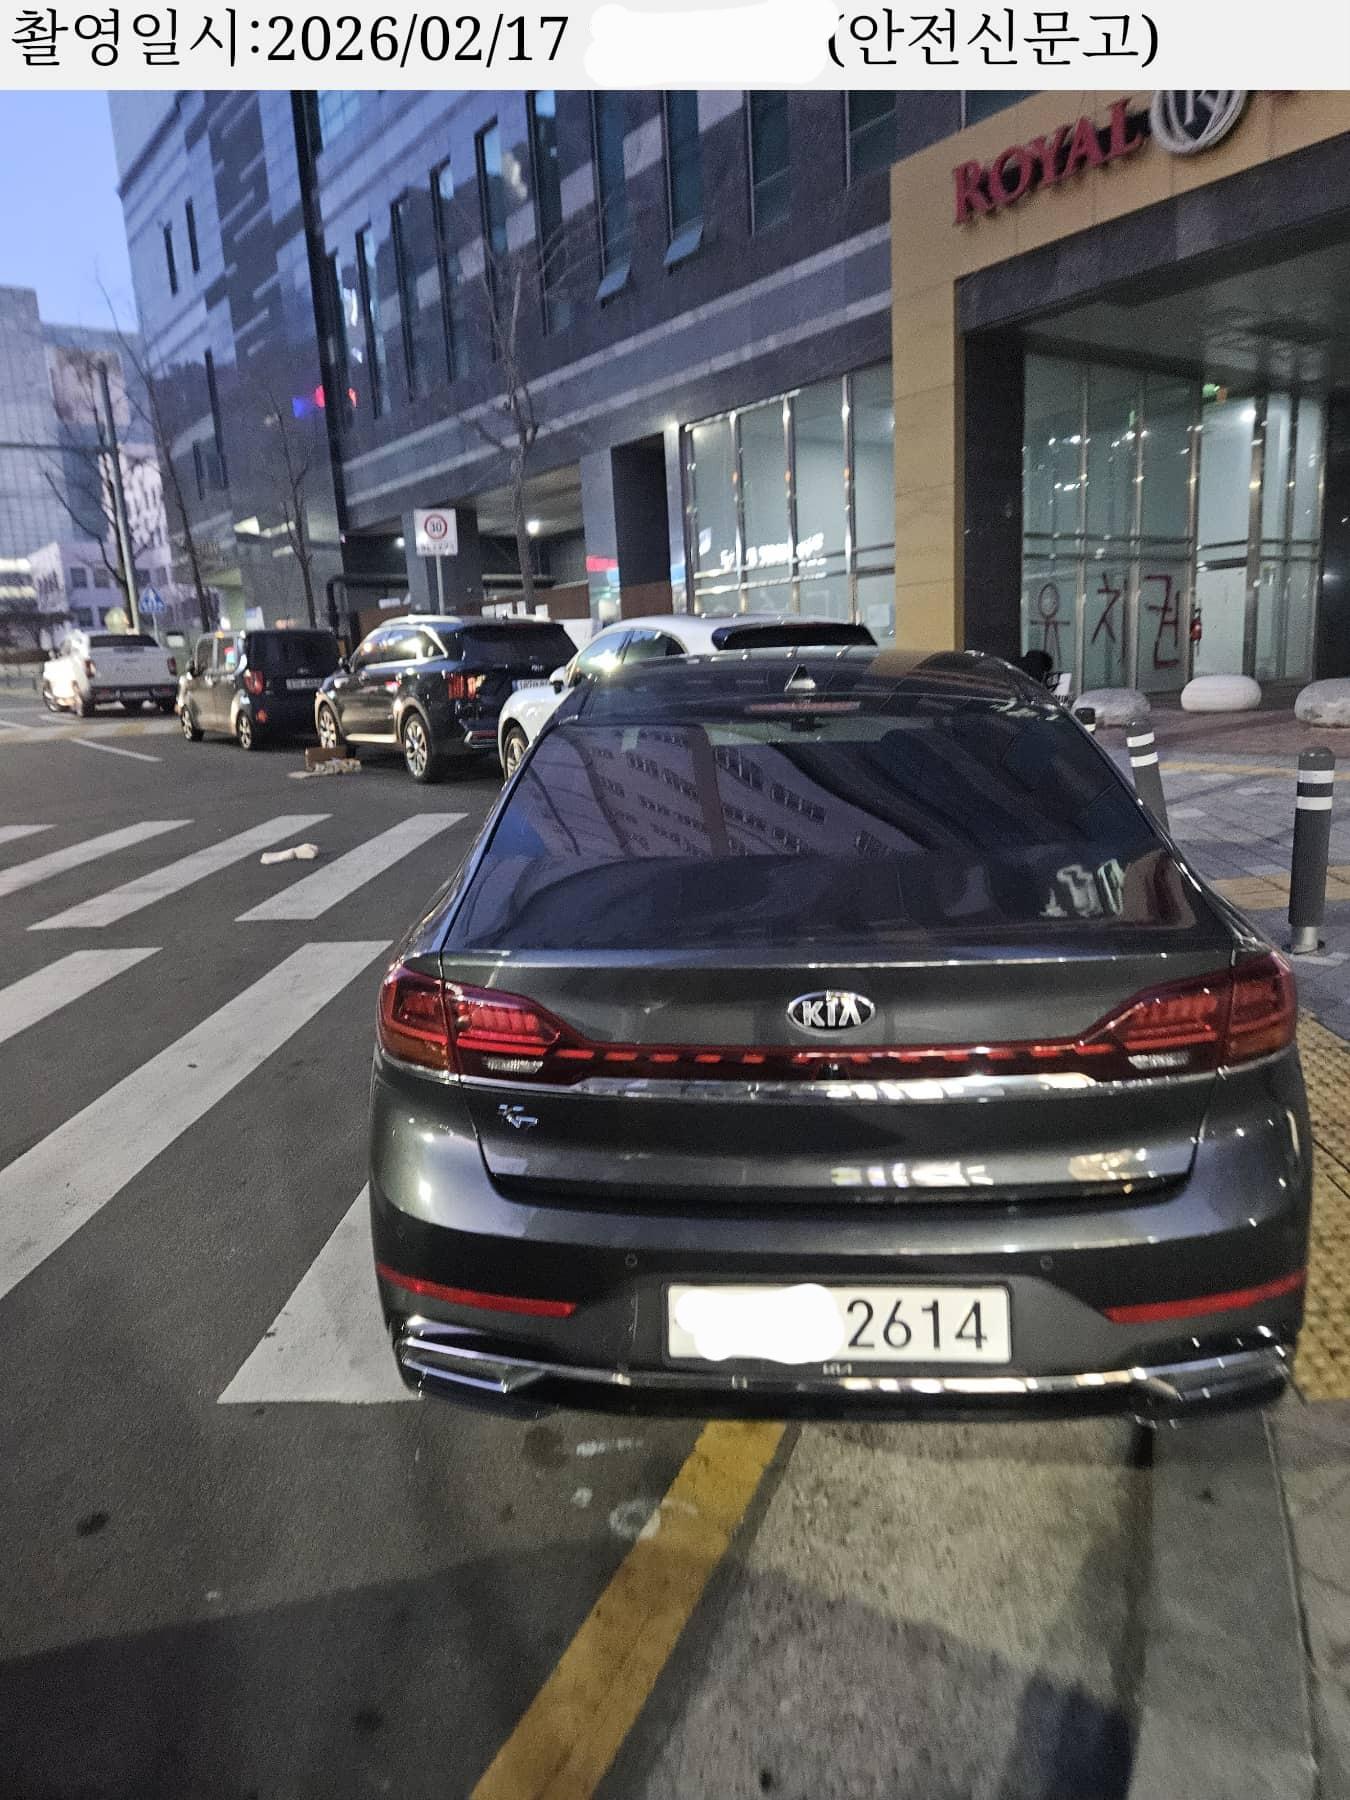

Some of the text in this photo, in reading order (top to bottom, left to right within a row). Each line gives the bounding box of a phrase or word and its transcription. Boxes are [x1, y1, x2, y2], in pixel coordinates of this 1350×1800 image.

[952, 97, 1147, 225] ROYAL
[801, 998, 862, 1027] KIA
[846, 1299, 987, 1350] 2614
